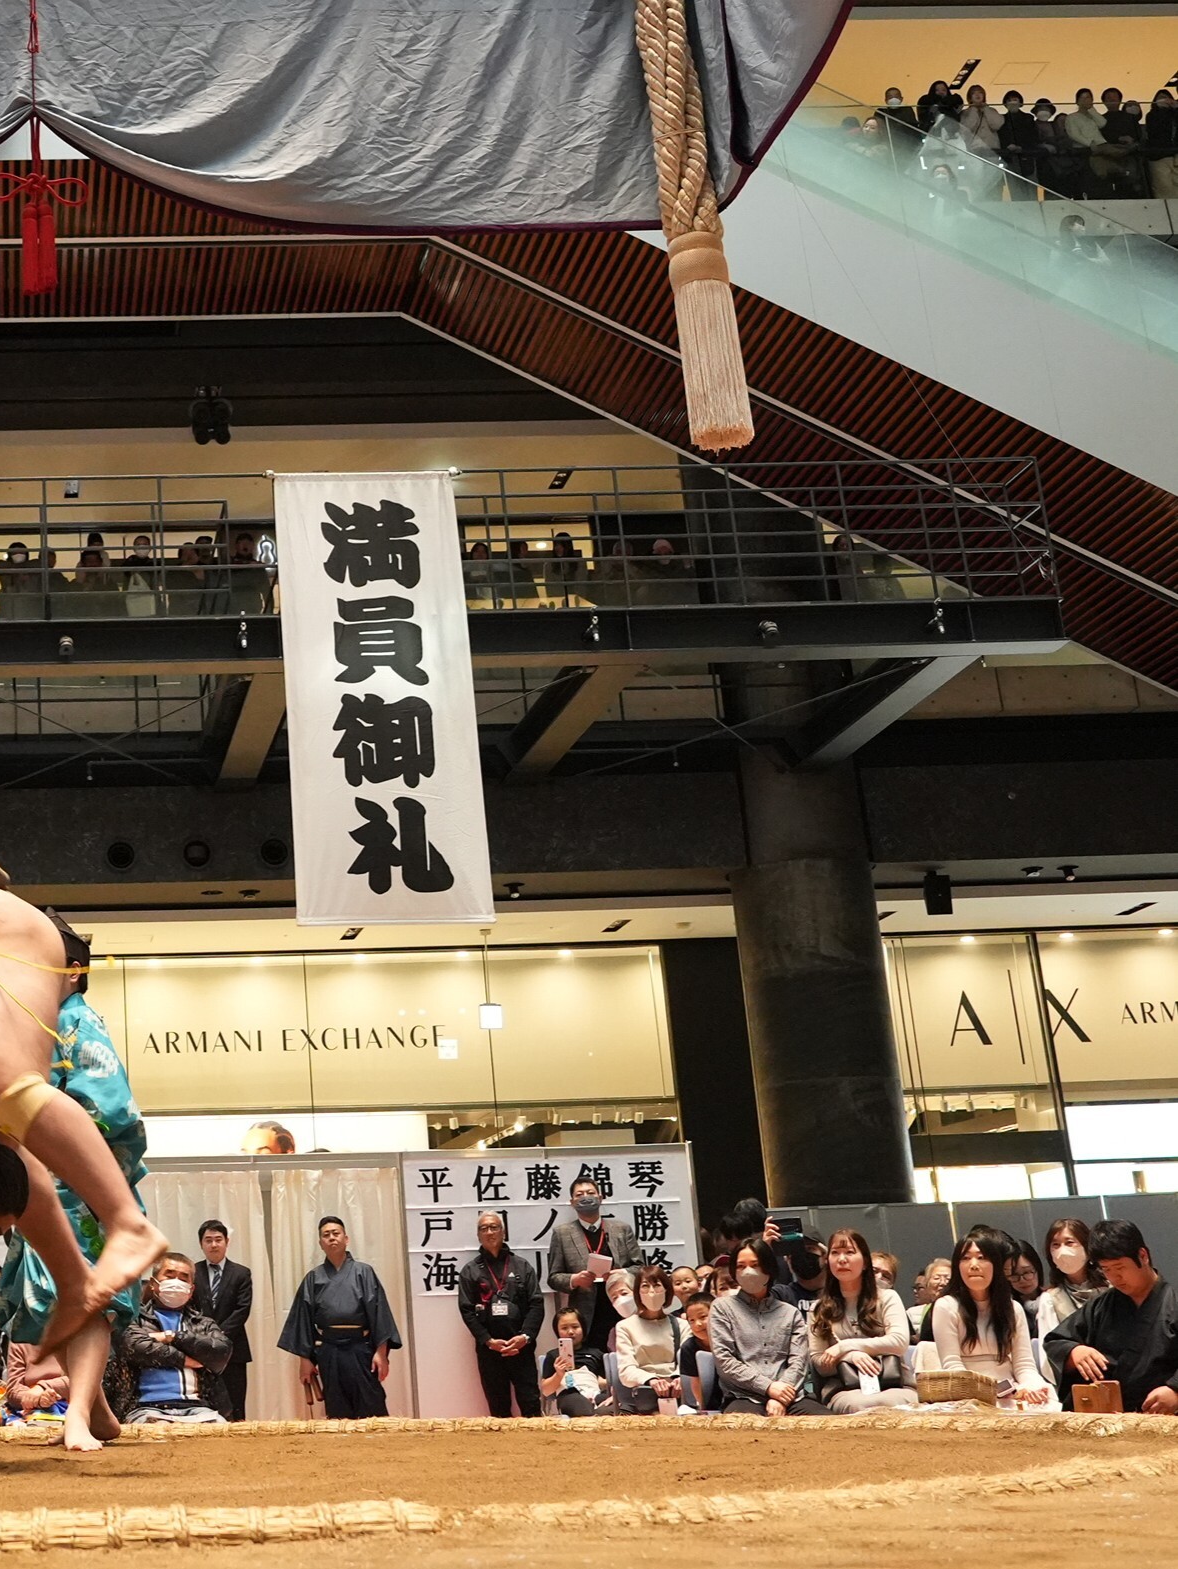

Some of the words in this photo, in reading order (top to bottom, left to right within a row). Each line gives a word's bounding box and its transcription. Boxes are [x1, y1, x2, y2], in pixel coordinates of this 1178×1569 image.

[321, 499, 455, 895] 満員御礼
[143, 1029, 263, 1054] ARMANI
[282, 1024, 446, 1052] EXCHANGE
[417, 1166, 459, 1291] 平戸海
